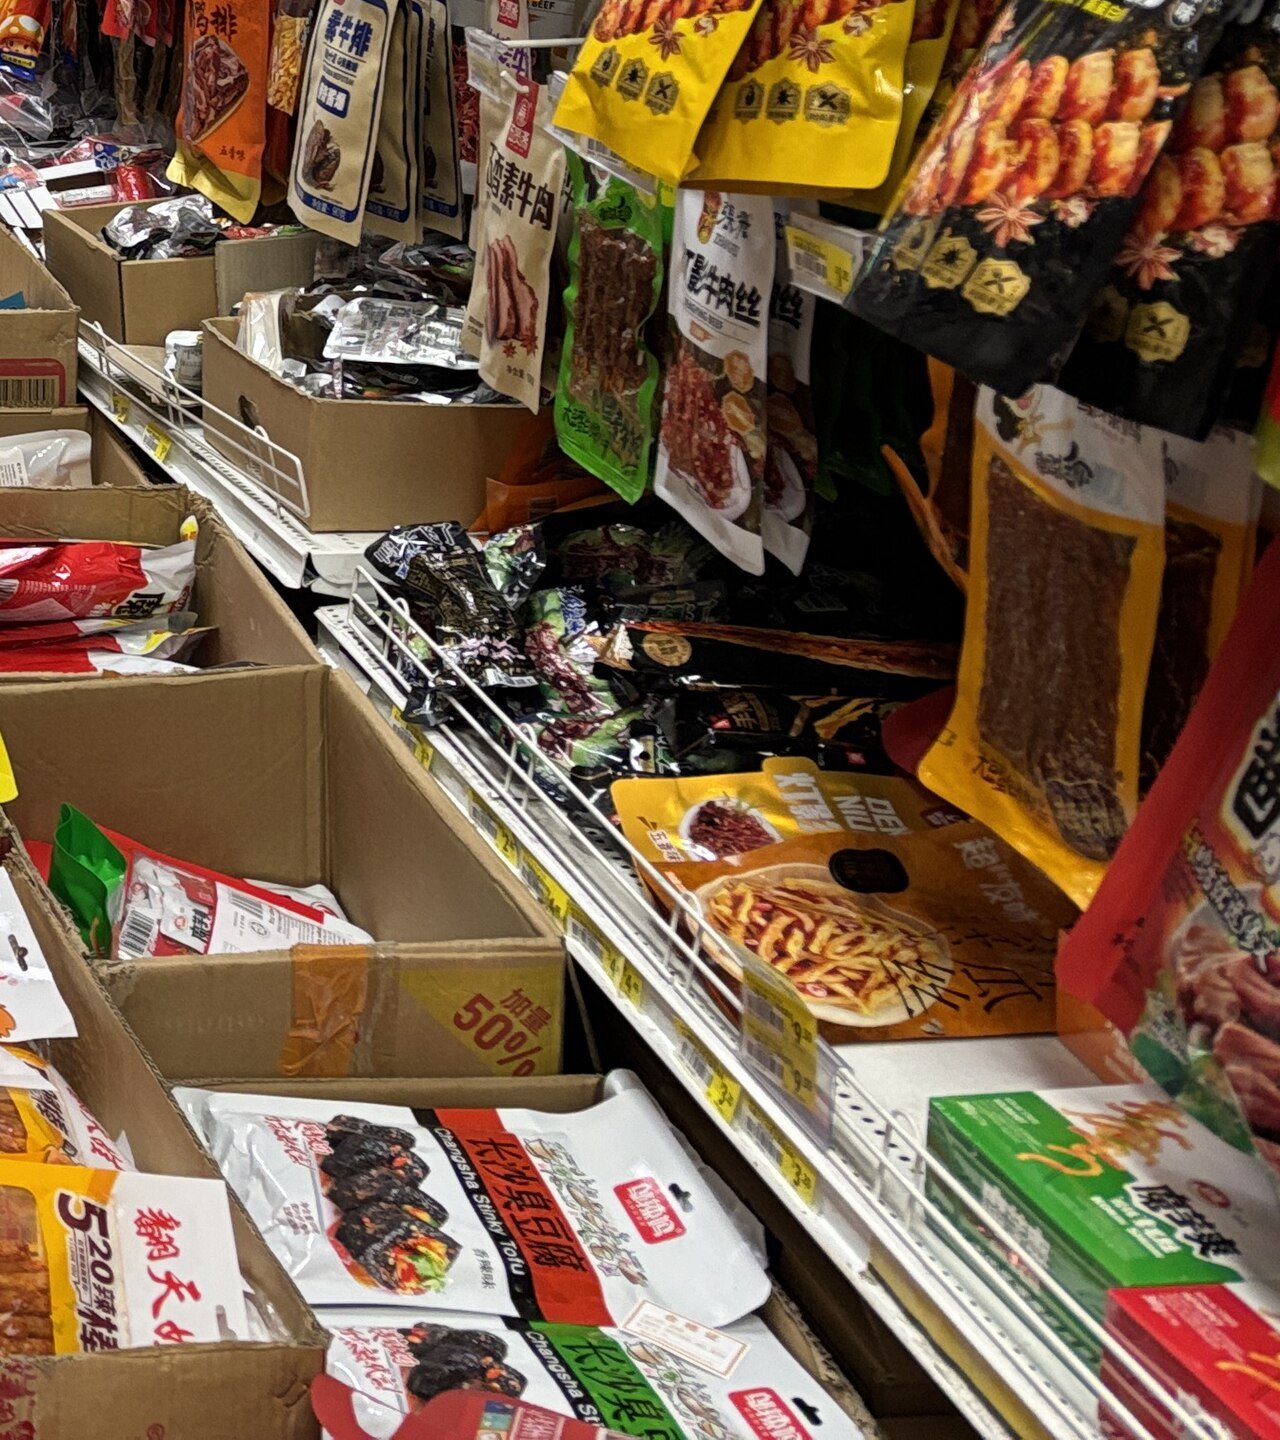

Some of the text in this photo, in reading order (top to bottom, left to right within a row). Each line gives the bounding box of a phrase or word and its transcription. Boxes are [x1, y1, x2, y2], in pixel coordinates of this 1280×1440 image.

[326, 9, 374, 57] 素牛排
[498, 988, 554, 1036] 加量
[434, 1127, 527, 1277] Changsha Stinky Tofu
[466, 1136, 589, 1274] 长沙臭豆腐
[526, 1330, 585, 1399] Changsha
